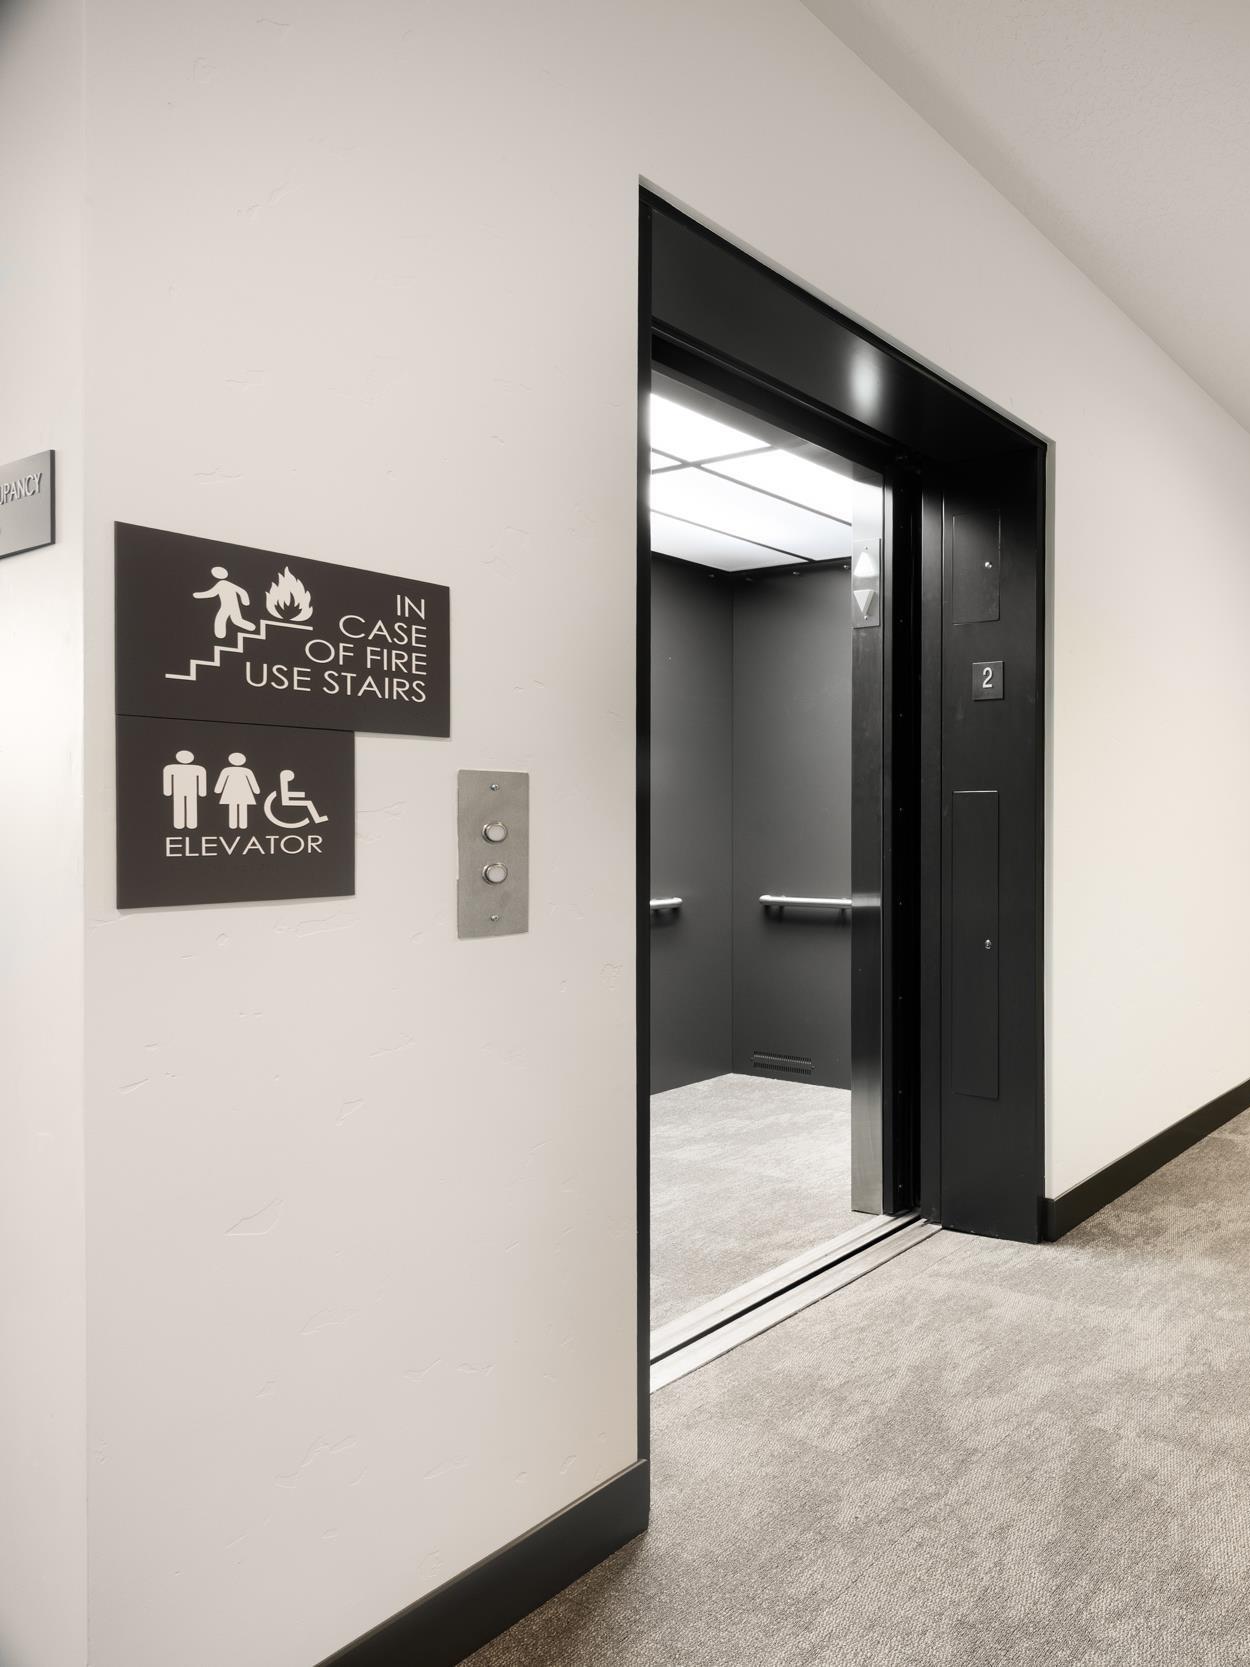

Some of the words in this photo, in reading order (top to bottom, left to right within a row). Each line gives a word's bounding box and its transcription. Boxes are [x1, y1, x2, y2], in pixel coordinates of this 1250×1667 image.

[396, 594, 425, 620] IN
[339, 614, 427, 648] CASE
[305, 639, 354, 665] OF
[366, 646, 427, 675] FIRE
[246, 661, 311, 692] USE
[322, 670, 426, 703] STAIRS
[982, 667, 993, 688] 2
[166, 835, 323, 857] ELEVATOR
